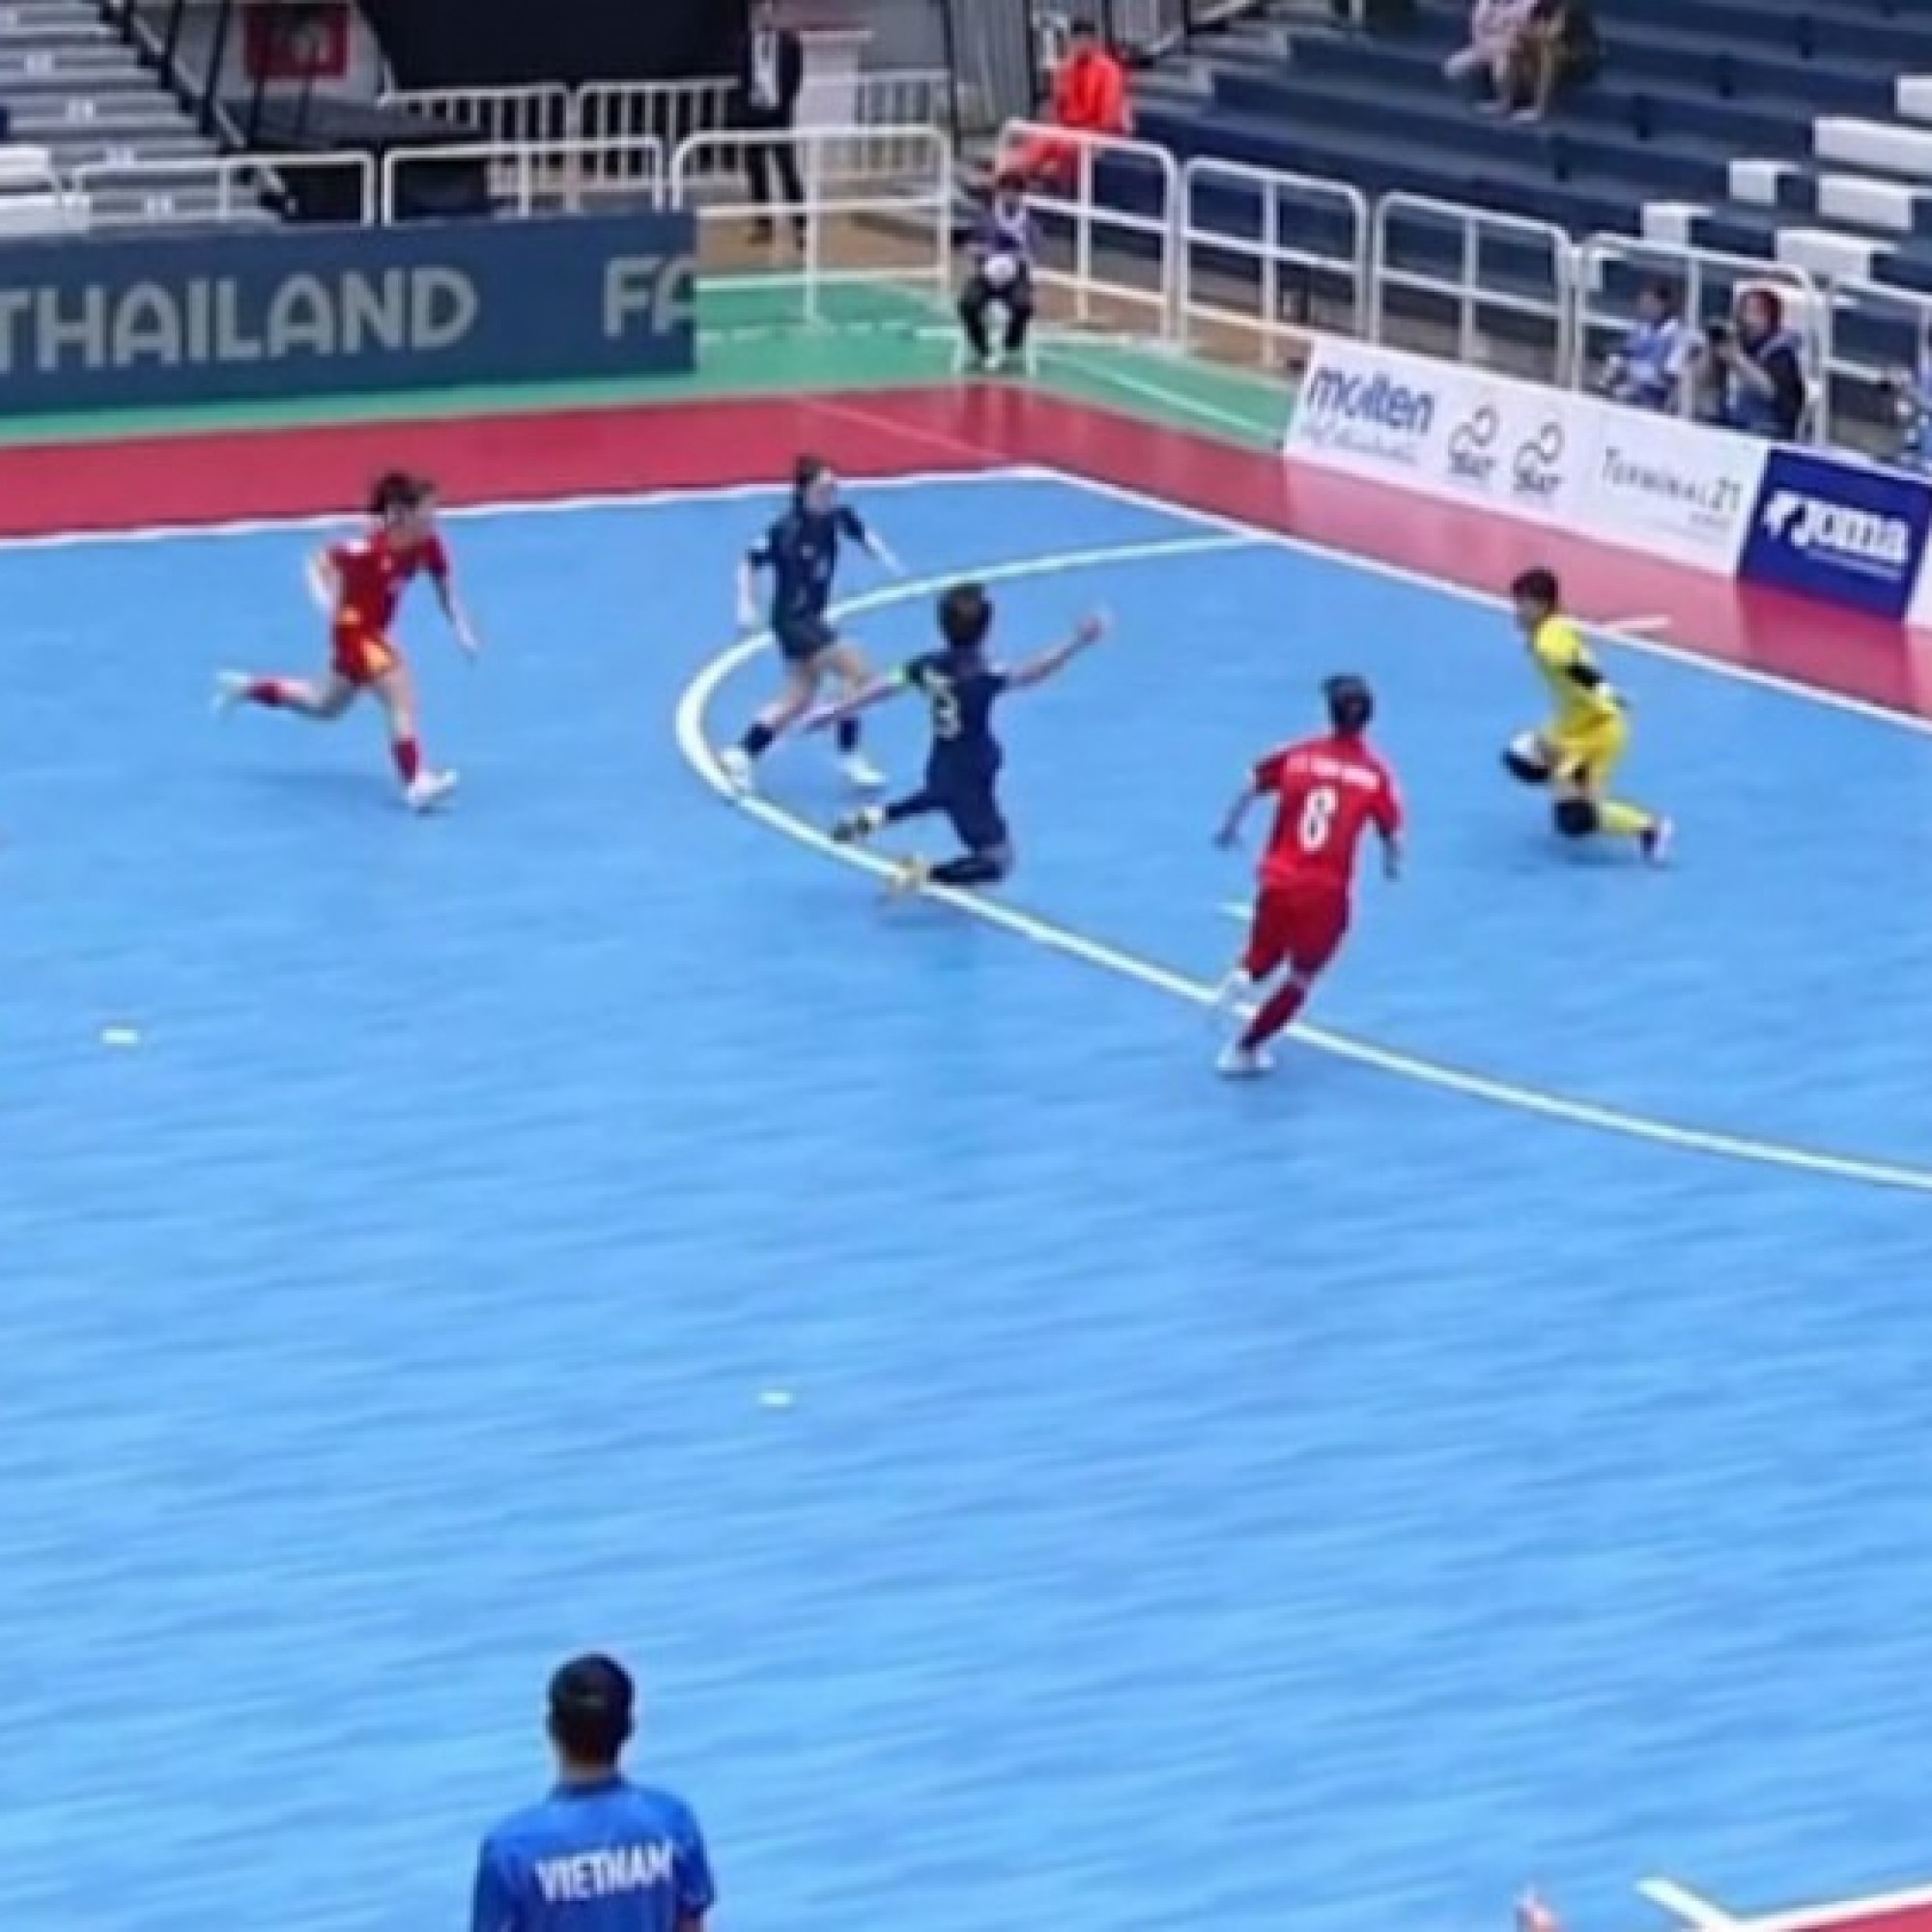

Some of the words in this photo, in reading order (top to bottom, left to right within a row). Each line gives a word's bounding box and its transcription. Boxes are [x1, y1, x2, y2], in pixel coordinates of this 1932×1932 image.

[0, 265, 479, 375] THAILAND
[1308, 367, 1435, 435] molten
[535, 1839, 672, 1900] VIETNAM
